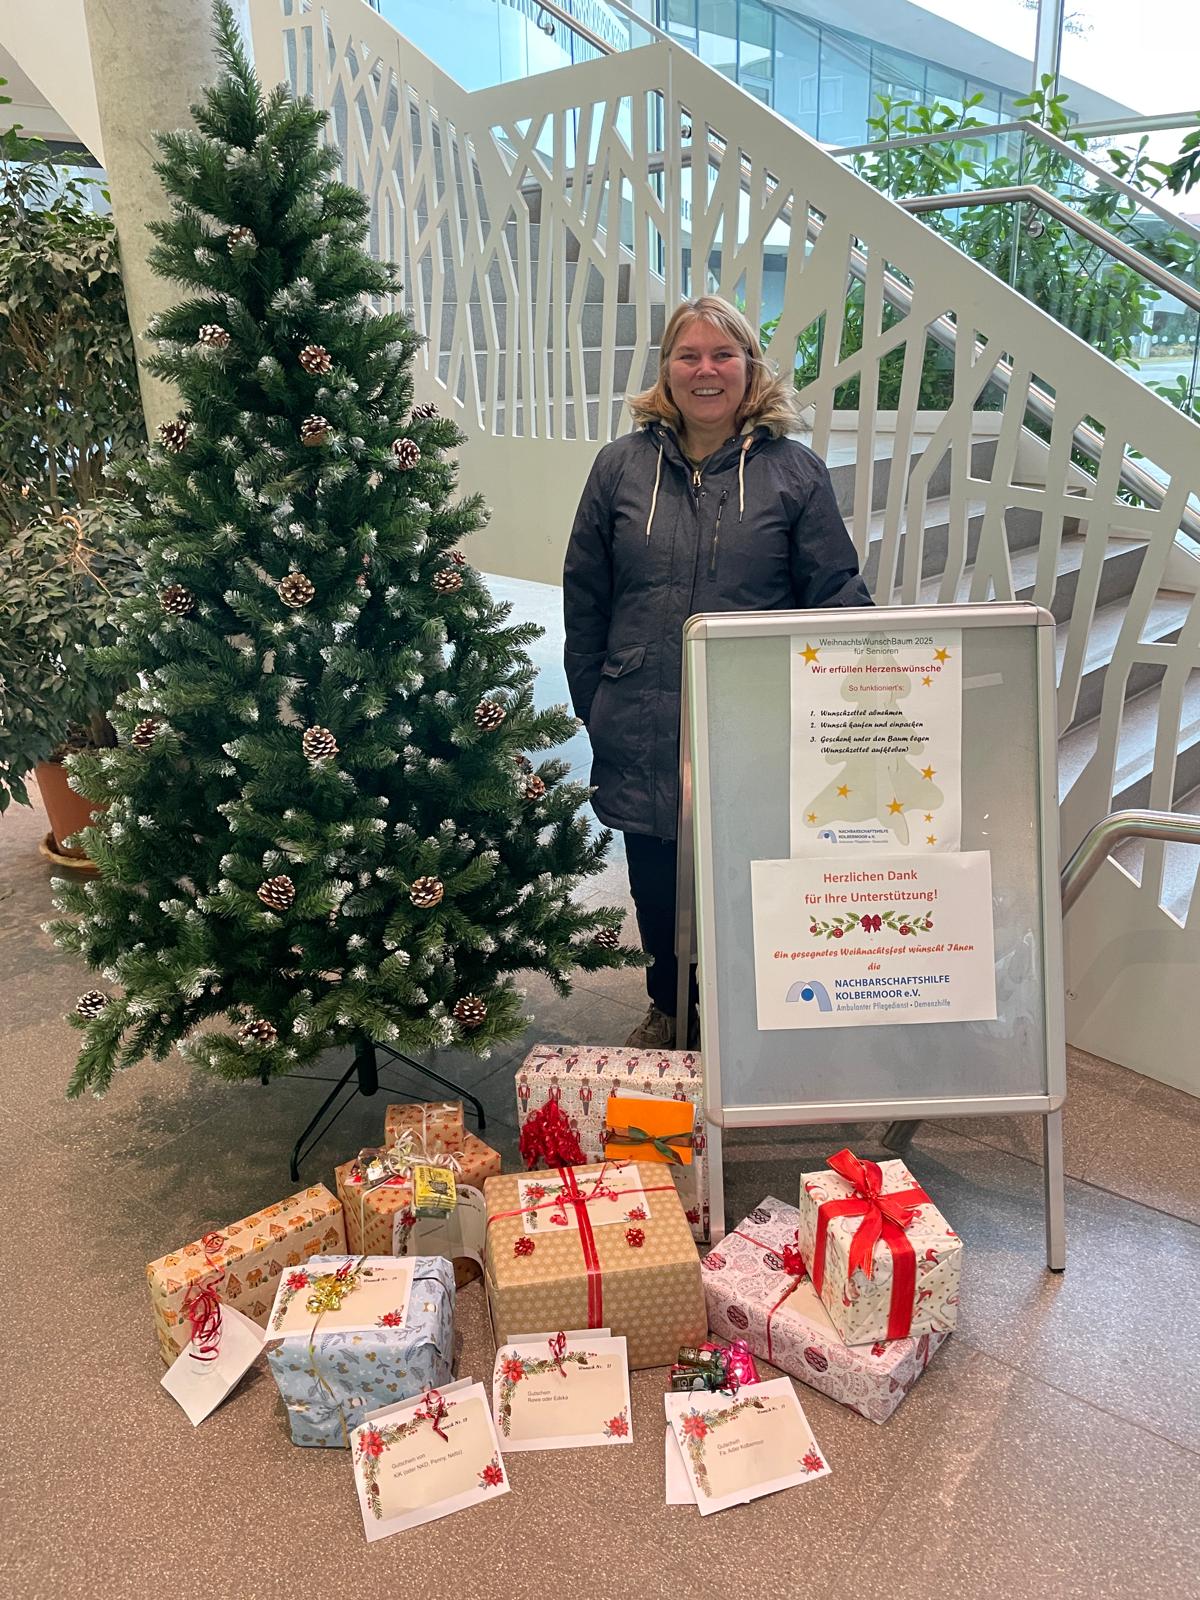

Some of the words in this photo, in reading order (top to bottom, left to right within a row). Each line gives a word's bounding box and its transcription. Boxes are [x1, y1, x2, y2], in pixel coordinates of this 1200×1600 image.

[819, 637, 913, 647] WeihnachtsWunschBaum
[914, 637, 934, 645] 2025
[811, 665, 828, 674] Wir
[829, 665, 863, 674] erfüllen
[865, 664, 942, 674] Herzenswünsche
[848, 684, 858, 692] So
[820, 709, 867, 717] Wunschzettel
[868, 709, 903, 717] abnehmen
[848, 722, 873, 730] kaufen
[889, 721, 923, 730] einpacken
[820, 735, 852, 744] Geschenk
[887, 735, 908, 743] Baum
[909, 735, 930, 743] legen
[820, 746, 870, 754] (Wunschzettel
[871, 746, 909, 754] aufkleben)
[823, 871, 884, 884] Herzlichen
[887, 869, 918, 881] Dank
[804, 893, 821, 905] für
[825, 892, 848, 904] Ihre
[850, 888, 938, 903] Unterstützung!
[773, 949, 789, 960] Ein
[790, 948, 838, 961] gesegnetes
[840, 946, 906, 957] Weihnachtsfest
[908, 944, 945, 954] wünscht
[946, 943, 974, 952] Ihnen
[867, 962, 881, 971] die
[834, 974, 950, 989] NACHBARSCHAFTSHILFE
[835, 988, 903, 1001] KOLBERMOOR
[903, 988, 921, 999] e.V.
[836, 1002, 871, 1012] Ambulanter
[872, 1000, 909, 1011] Pflegedienst
[913, 999, 951, 1009] Demenzhilfe
